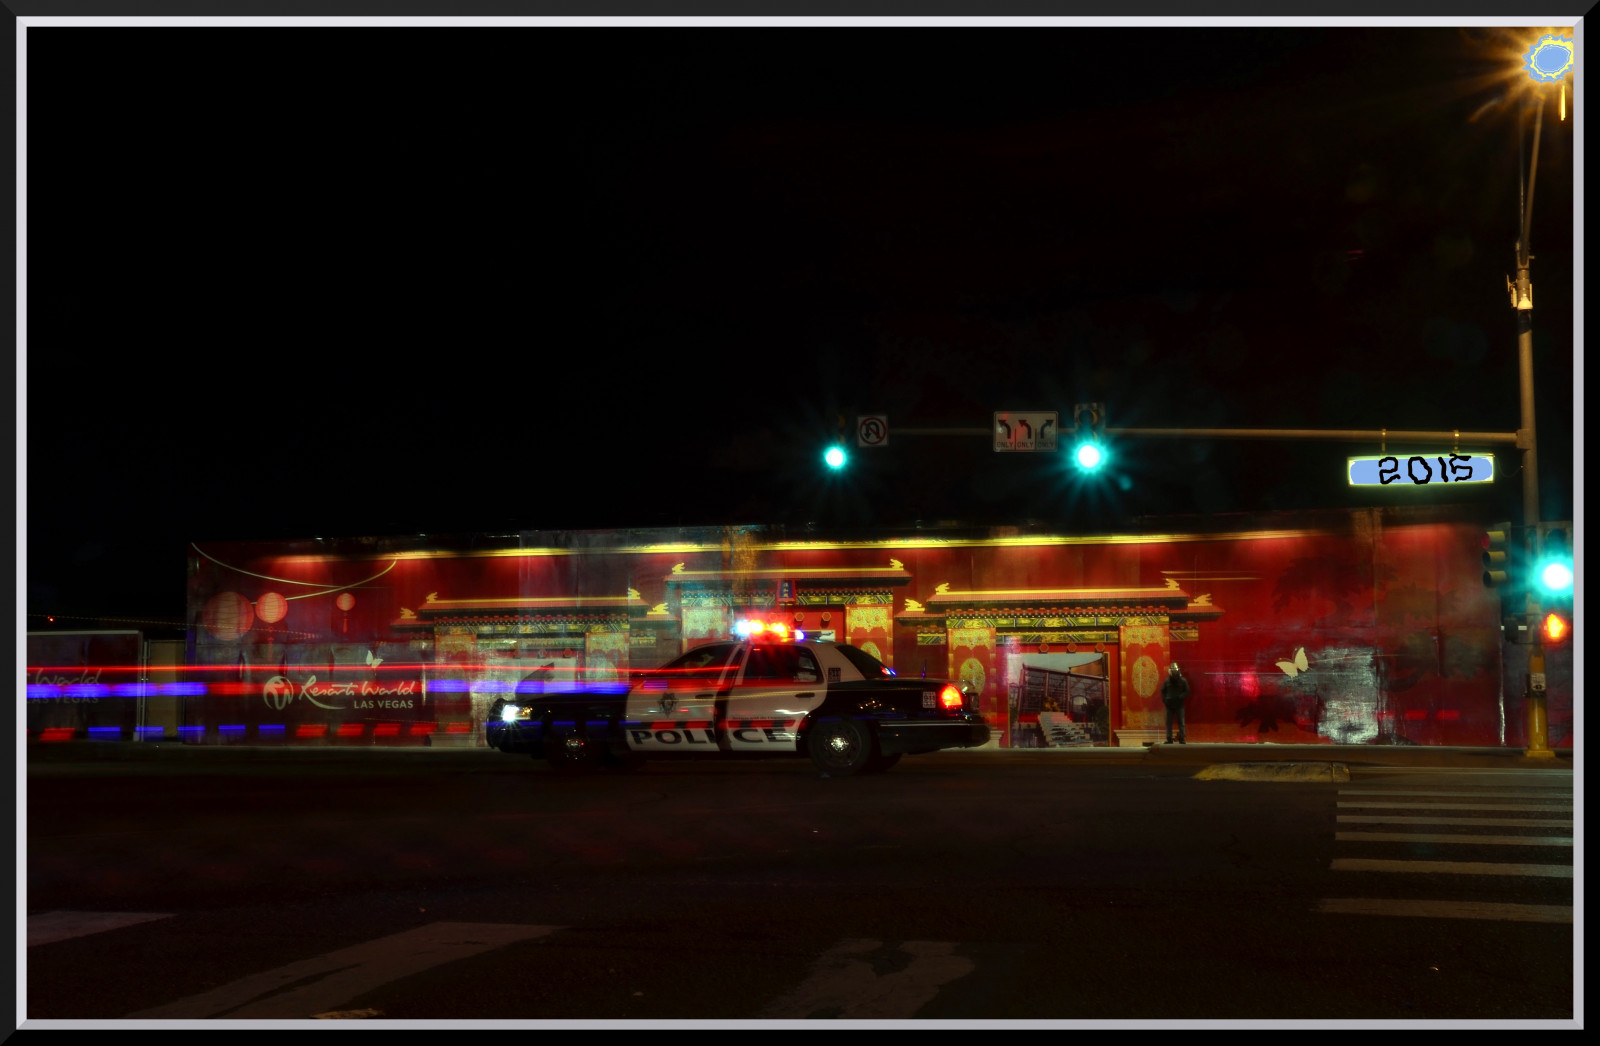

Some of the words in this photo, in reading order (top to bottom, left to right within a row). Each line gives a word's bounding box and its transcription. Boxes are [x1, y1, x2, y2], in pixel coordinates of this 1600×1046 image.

[298, 674, 359, 710] Resorts
[361, 680, 416, 697] World
[353, 699, 375, 710] LAS
[377, 699, 414, 710] VEGAS
